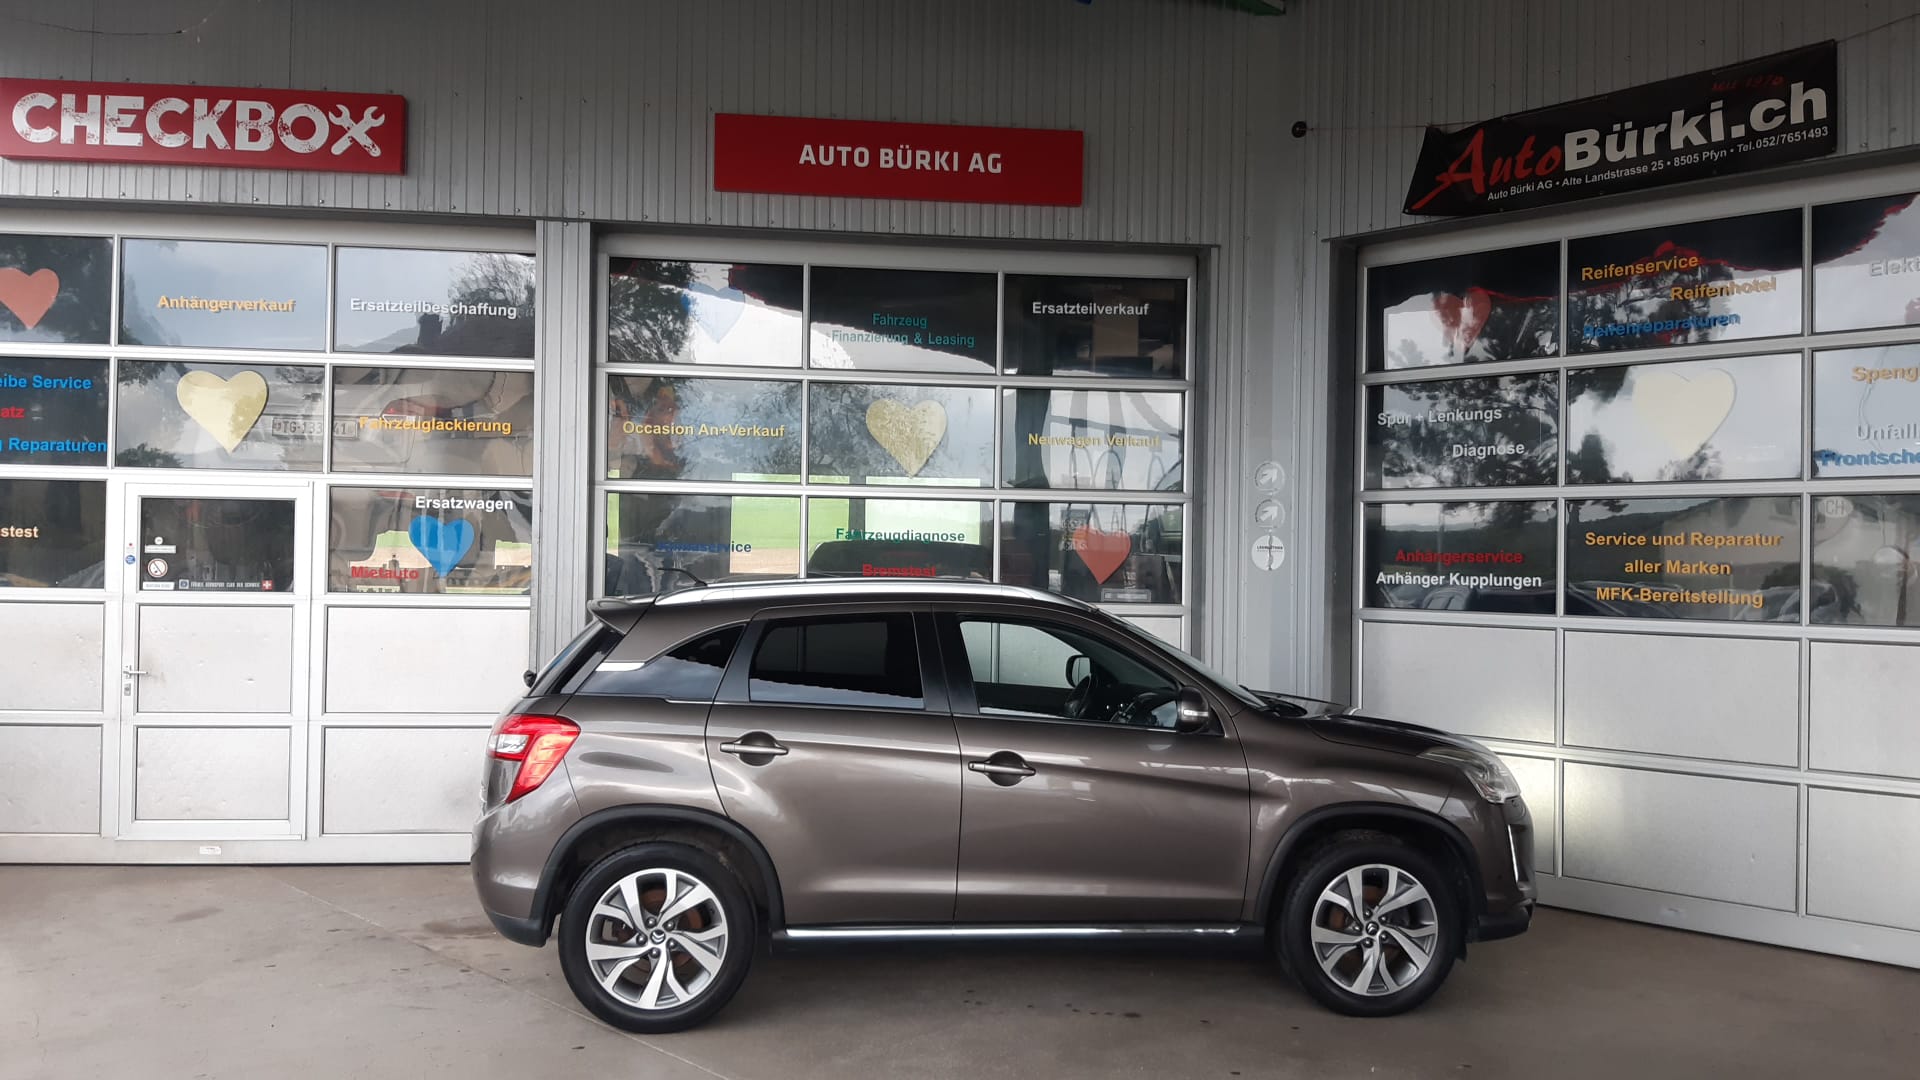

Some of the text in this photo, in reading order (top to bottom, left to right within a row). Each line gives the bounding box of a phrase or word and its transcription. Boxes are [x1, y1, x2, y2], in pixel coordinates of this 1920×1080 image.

[12, 92, 386, 158] CHECKBOX
[799, 144, 1002, 174] AUTO BÜRKI AG
[1487, 189, 1509, 201] Auto
[1510, 182, 1535, 196] Bürki
[1536, 180, 1553, 191] AG
[1562, 177, 1582, 188] Alte
[1585, 165, 1649, 184] Landstrasse
[1651, 160, 1665, 172] 25
[1673, 152, 1700, 167] 8505
[1702, 149, 1727, 162] Pfyn
[1581, 256, 1700, 281] Reifenservice
[1669, 276, 1778, 301] Reifenhotel
[157, 295, 296, 313] Anhängerverkauf
[350, 298, 517, 319] Ersatzteilbeschaffung
[1032, 301, 1150, 316] Ersatzteilverkauf
[872, 313, 928, 329] Fahrzeug
[831, 330, 975, 348] Finanzierung & Leasing
[32, 374, 92, 389] Service
[0, 405, 25, 418] atz
[1377, 408, 1502, 429] Spur + Lenkungs
[359, 416, 513, 435] Fahrzeuglackierung
[623, 421, 785, 438] Occasion An+Verkauf
[8, 437, 108, 454] Reparaturen
[1028, 433, 1161, 449] Neuwagen Verkauf
[1452, 442, 1525, 459] Diagnose
[415, 496, 513, 512] Ersatzwagen
[836, 528, 965, 544] Fahrzeugdiagnose
[1584, 532, 1783, 549] Service und Reparatur
[1395, 549, 1524, 566] Anhängerservice
[351, 565, 419, 580] Mietauto
[862, 564, 937, 577] Bremstest
[1624, 559, 1731, 575] aller Marken
[1376, 571, 1542, 590] Anhänger Kupplungen
[1596, 587, 1764, 609] MFK-Bereitstellung
